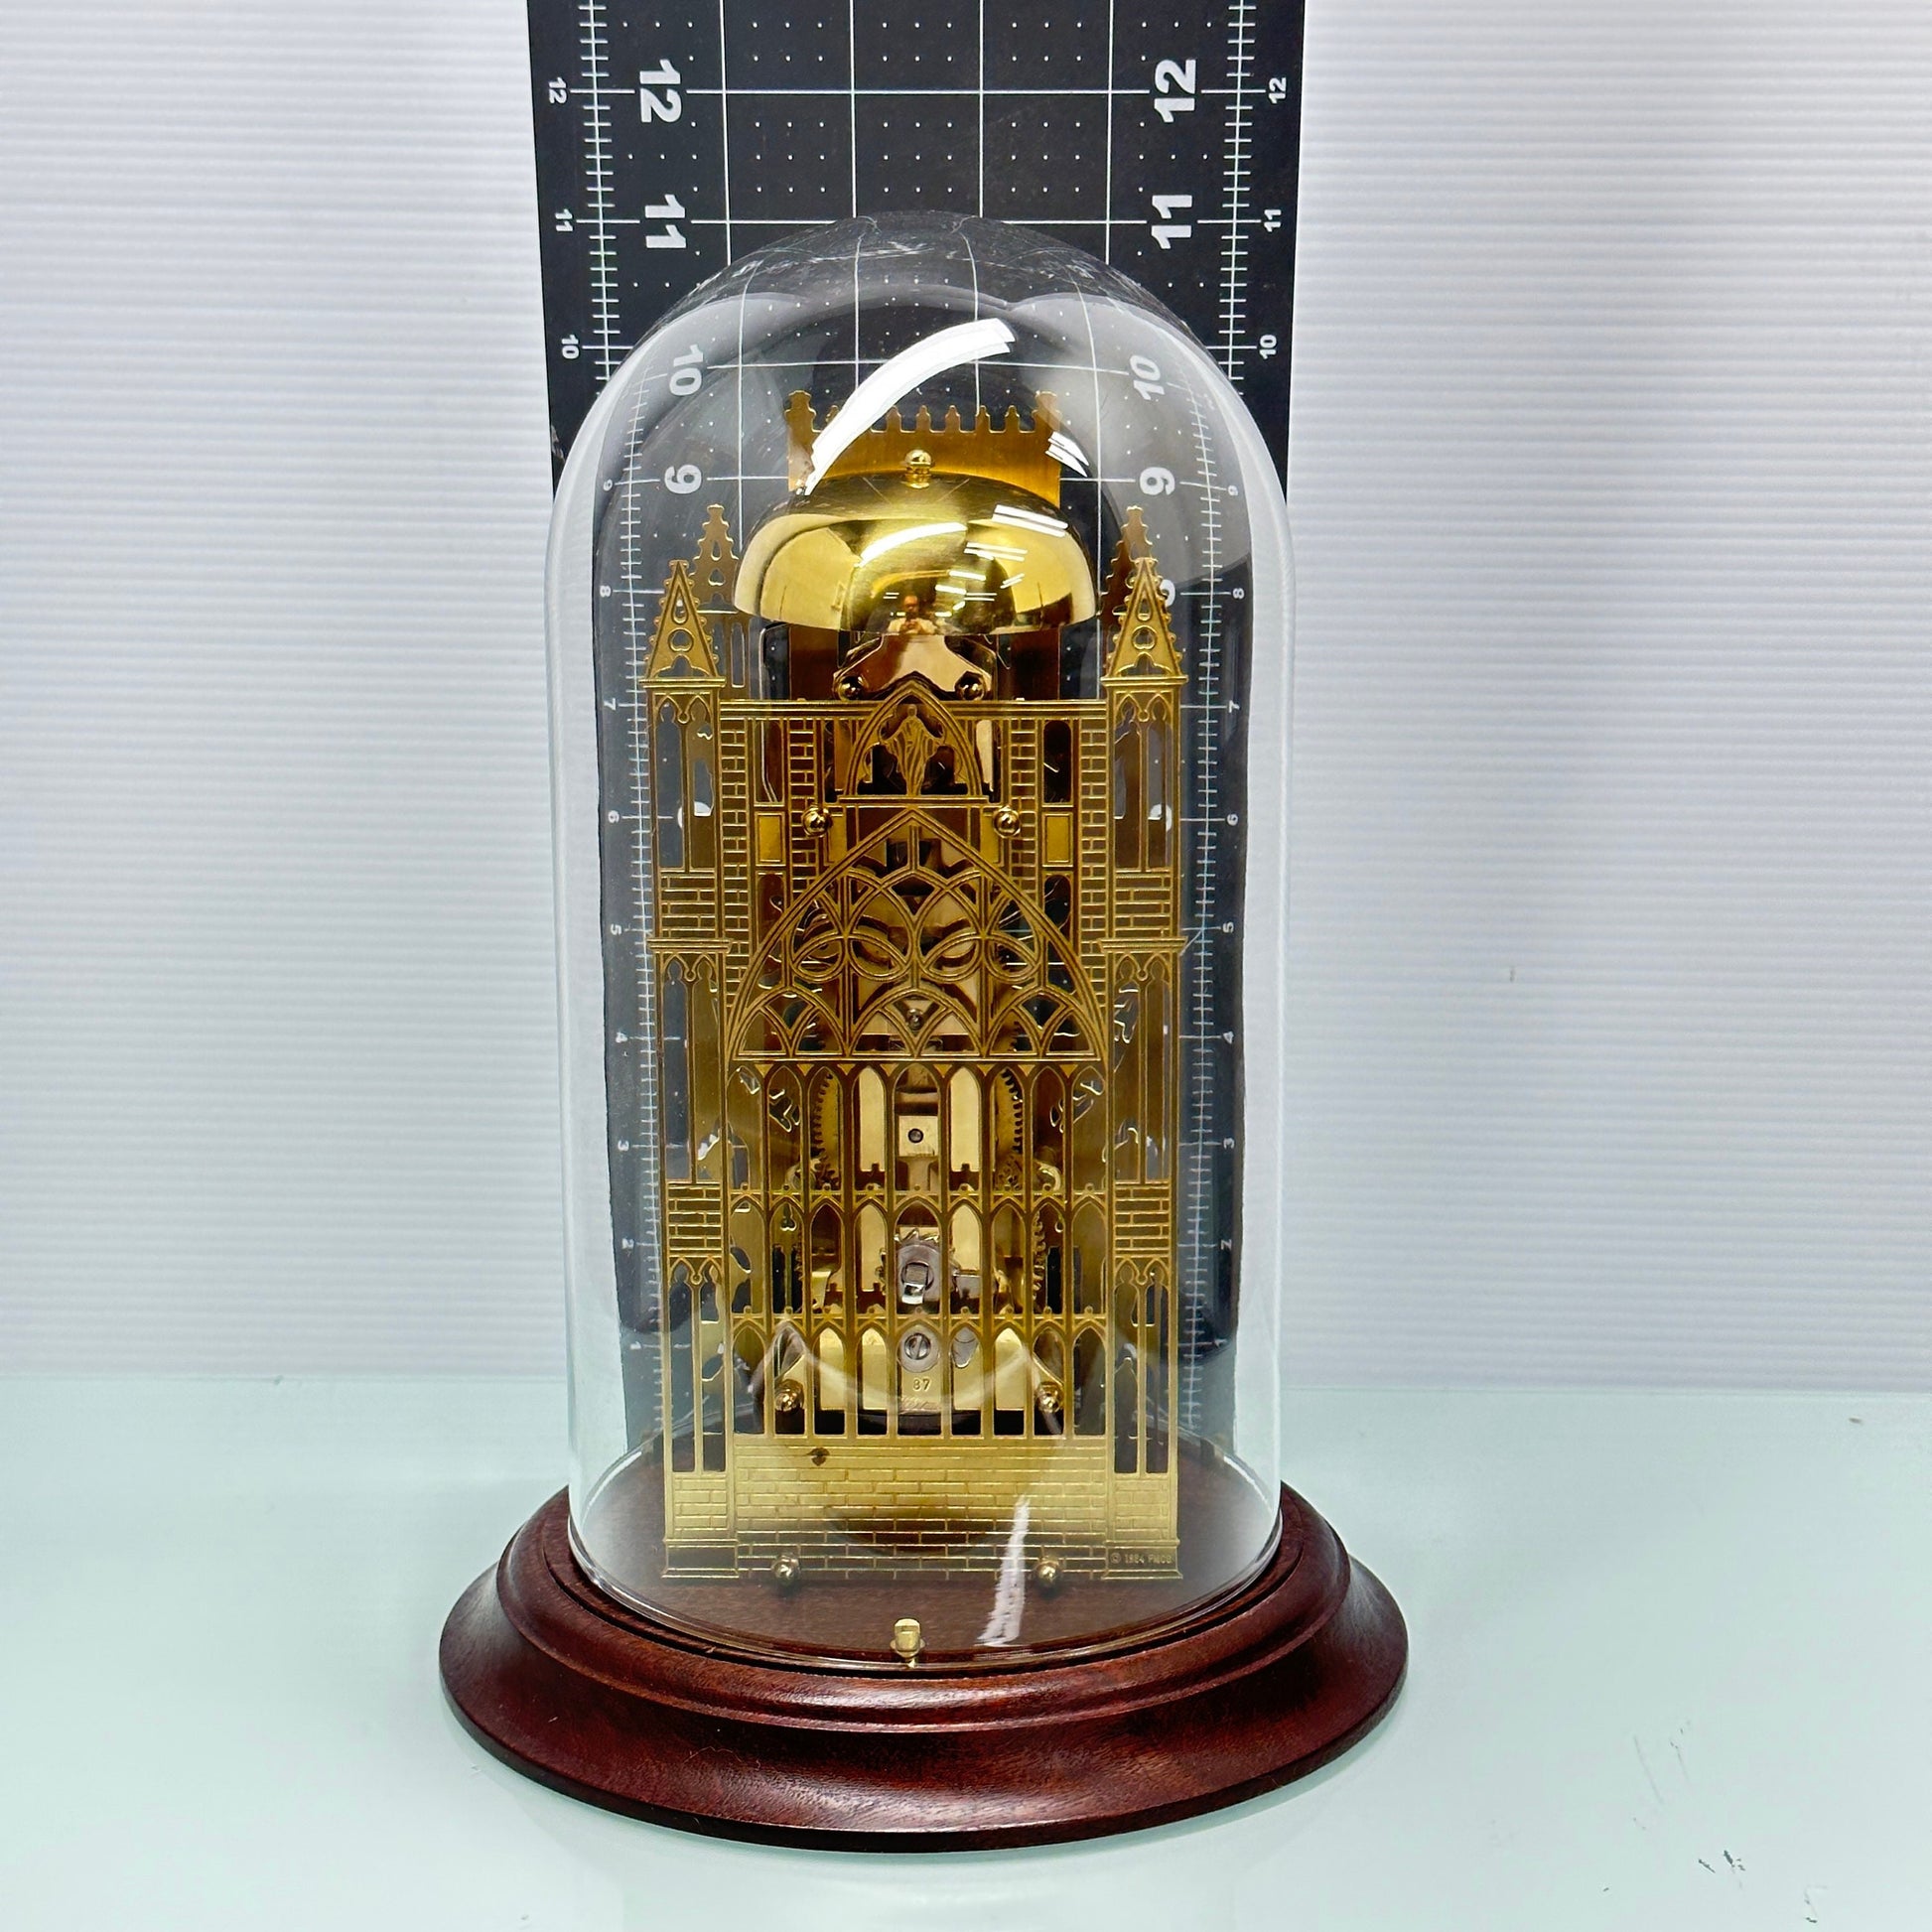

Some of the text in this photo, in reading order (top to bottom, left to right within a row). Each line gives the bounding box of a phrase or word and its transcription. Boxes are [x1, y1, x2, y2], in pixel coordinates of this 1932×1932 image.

[548, 76, 567, 104] 12
[639, 59, 682, 122] 12
[1154, 59, 1196, 122] 12
[1268, 76, 1287, 104] 12
[554, 208, 574, 232] 11
[644, 194, 687, 248] 11
[1151, 195, 1193, 249] 11
[1263, 208, 1282, 232] 11
[561, 334, 580, 359] 10
[1259, 334, 1278, 359] 10
[669, 344, 705, 397] 10
[1129, 354, 1166, 400] 10
[664, 464, 702, 494] 9
[1140, 467, 1175, 495] 9
[600, 585, 612, 597] 8
[1232, 588, 1245, 600] 8
[604, 697, 617, 711] 7
[1228, 700, 1240, 713] 7
[611, 923, 622, 935] 5
[1222, 921, 1234, 933] 5
[618, 1140, 629, 1152] 3
[1223, 1138, 1235, 1149] 3
[912, 1377, 931, 1391] 87
